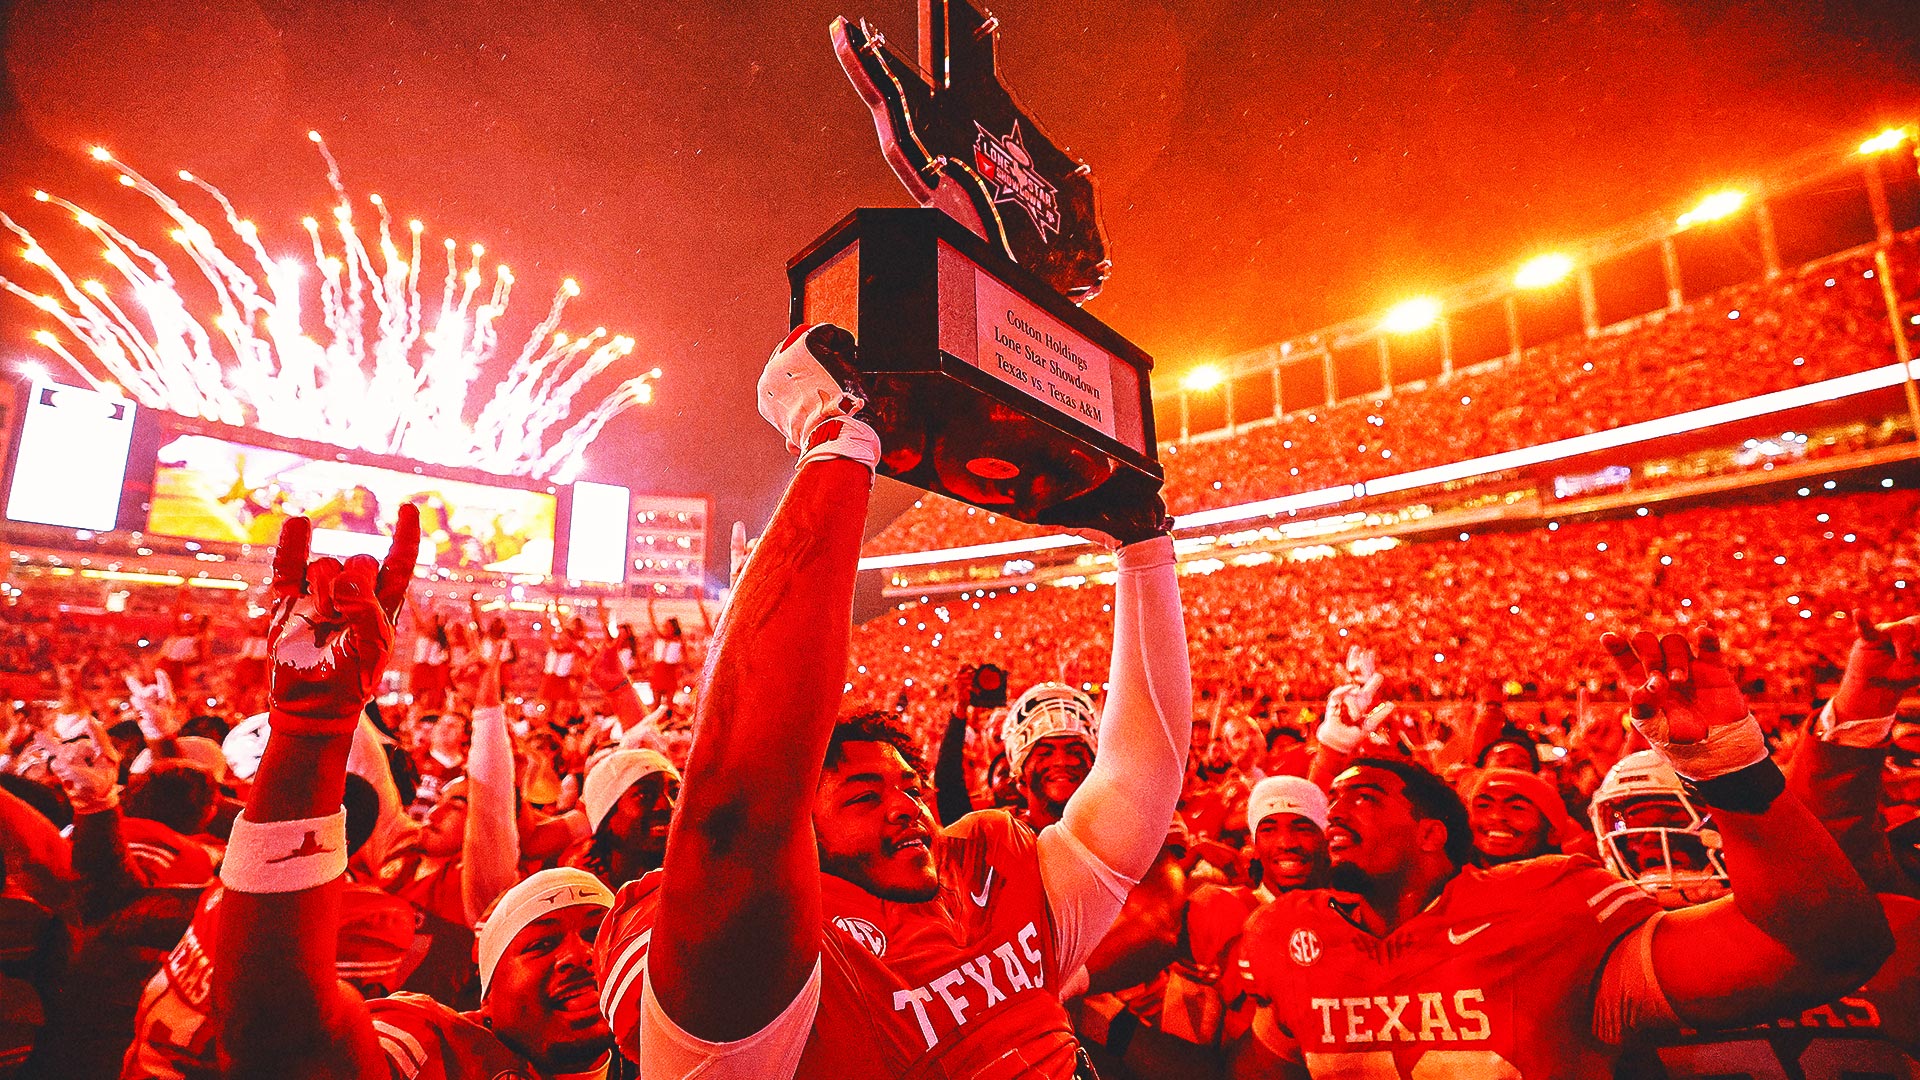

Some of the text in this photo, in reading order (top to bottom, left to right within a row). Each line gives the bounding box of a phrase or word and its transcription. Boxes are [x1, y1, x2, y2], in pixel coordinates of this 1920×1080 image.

[984, 142, 1011, 172] LONE
[994, 325, 1101, 400] Lone Star Showdown
[1006, 310, 1088, 371] Cotton Holdings
[995, 352, 1102, 423] Texas vs. Texas A&M
[1291, 930, 1321, 963] SEC
[892, 921, 1044, 1052] TEXAS
[1311, 988, 1492, 1043] TEXAS
